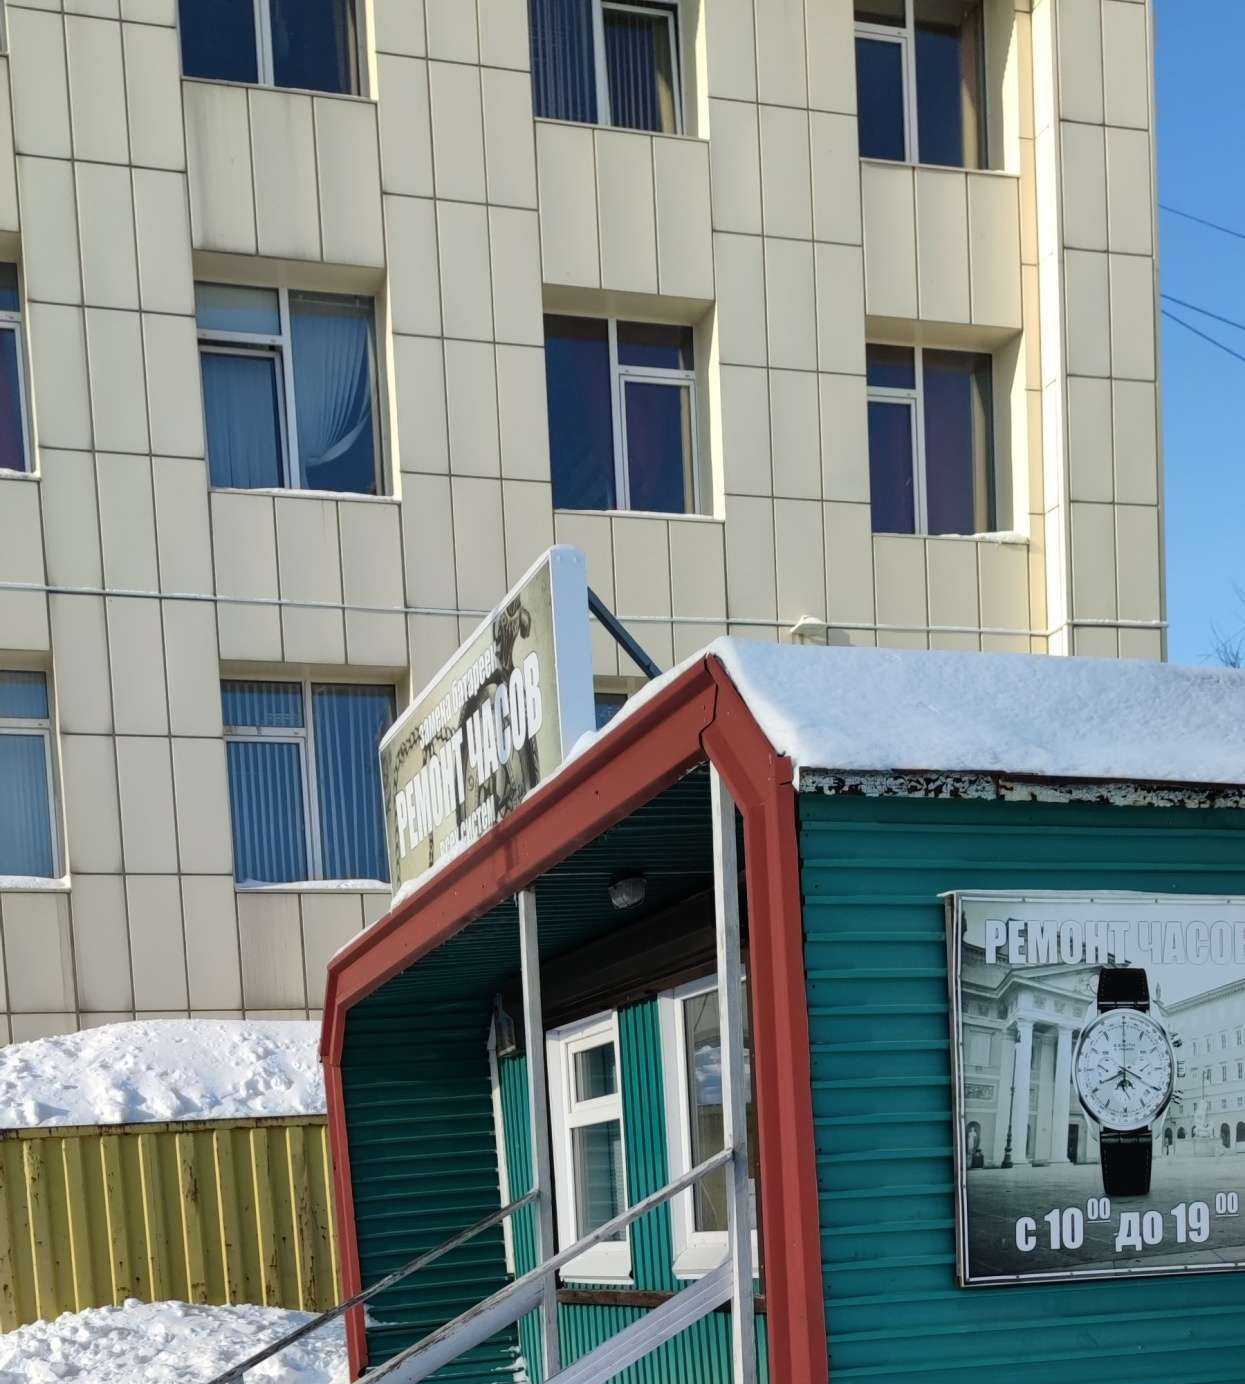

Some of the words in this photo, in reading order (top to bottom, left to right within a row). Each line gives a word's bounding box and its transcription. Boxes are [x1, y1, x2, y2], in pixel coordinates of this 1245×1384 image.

[418, 693, 451, 750] замена
[395, 727, 465, 858] РЕМОНТ
[466, 651, 542, 785] ЧАСОВ
[984, 919, 1131, 965] РЕМОНТ
[1114, 1211, 1163, 1252] до
